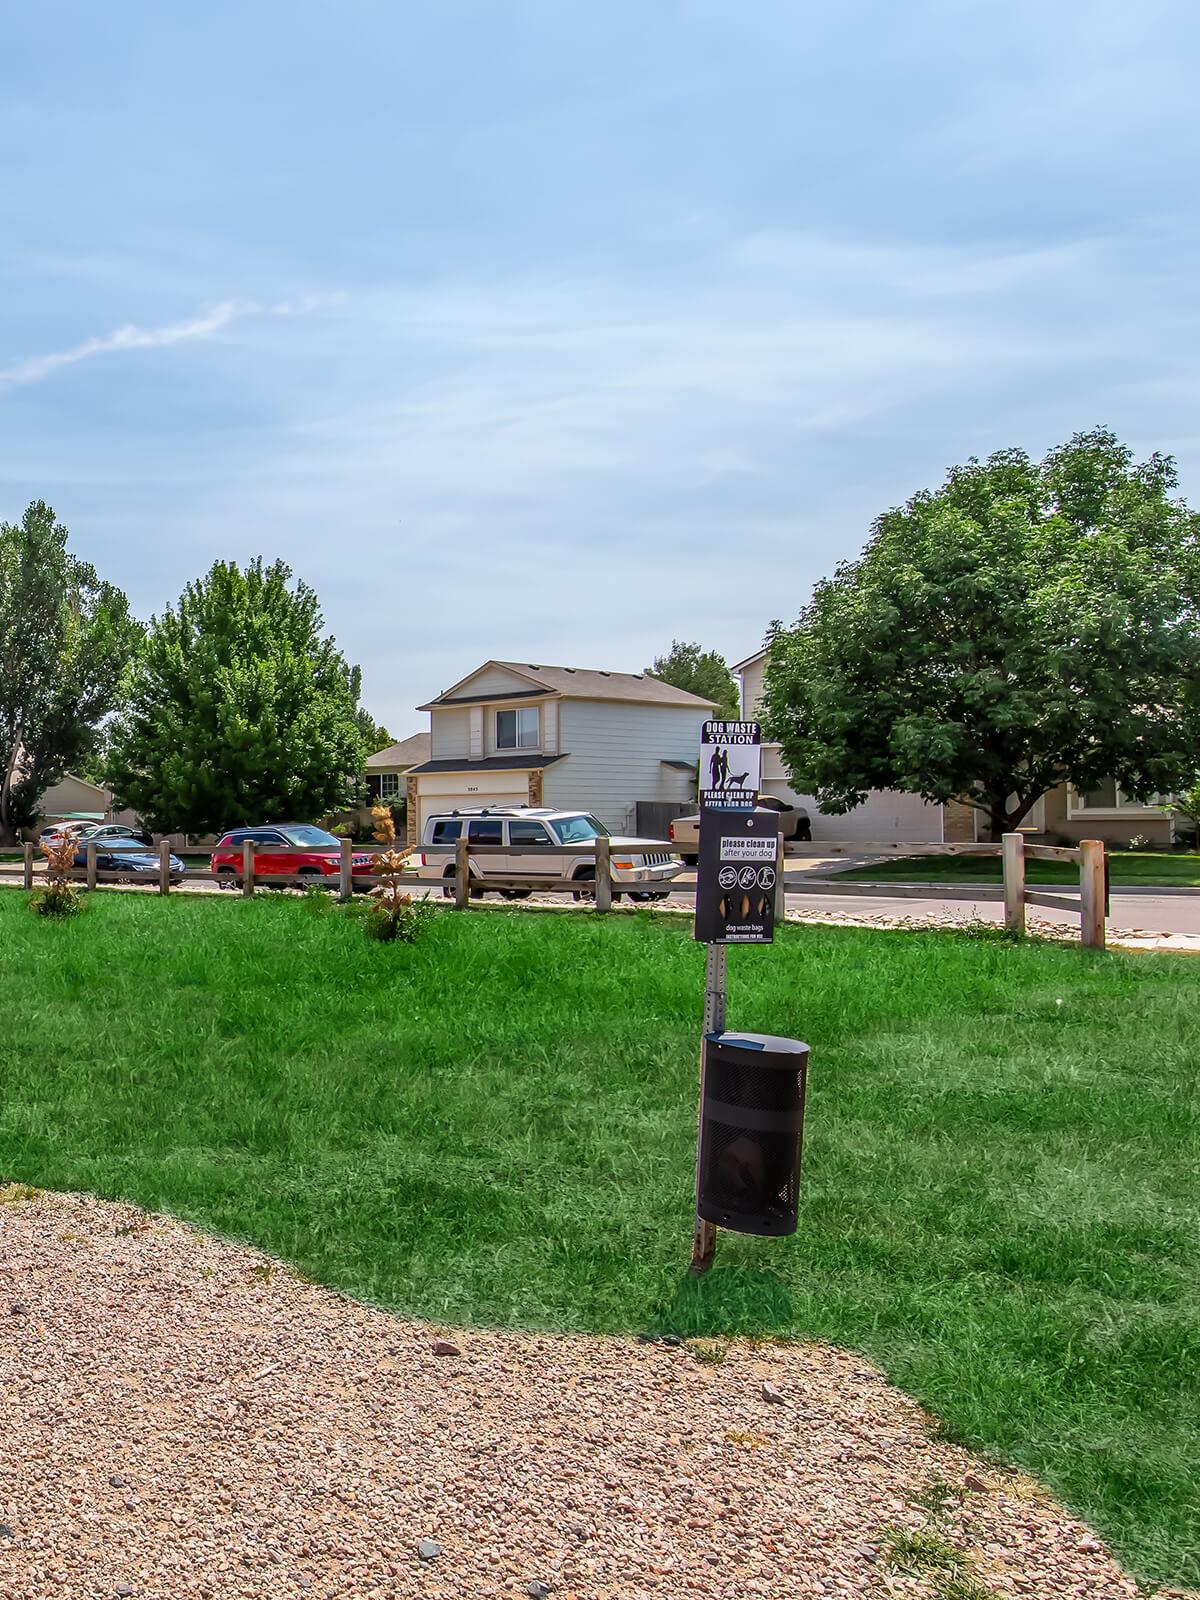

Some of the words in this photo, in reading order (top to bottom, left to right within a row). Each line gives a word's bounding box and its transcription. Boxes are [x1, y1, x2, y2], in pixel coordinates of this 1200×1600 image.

[706, 722, 724, 733] DOG
[726, 722, 757, 733] WASTE
[709, 734, 753, 744] STATION
[704, 791, 725, 799] PLEASE
[726, 791, 744, 799] CLEAN
[722, 839, 745, 848] please
[746, 839, 765, 848] clean
[766, 841, 775, 849] up
[724, 848, 740, 856] after
[742, 850, 757, 858] your
[759, 849, 772, 859] dog
[725, 924, 736, 932] dog
